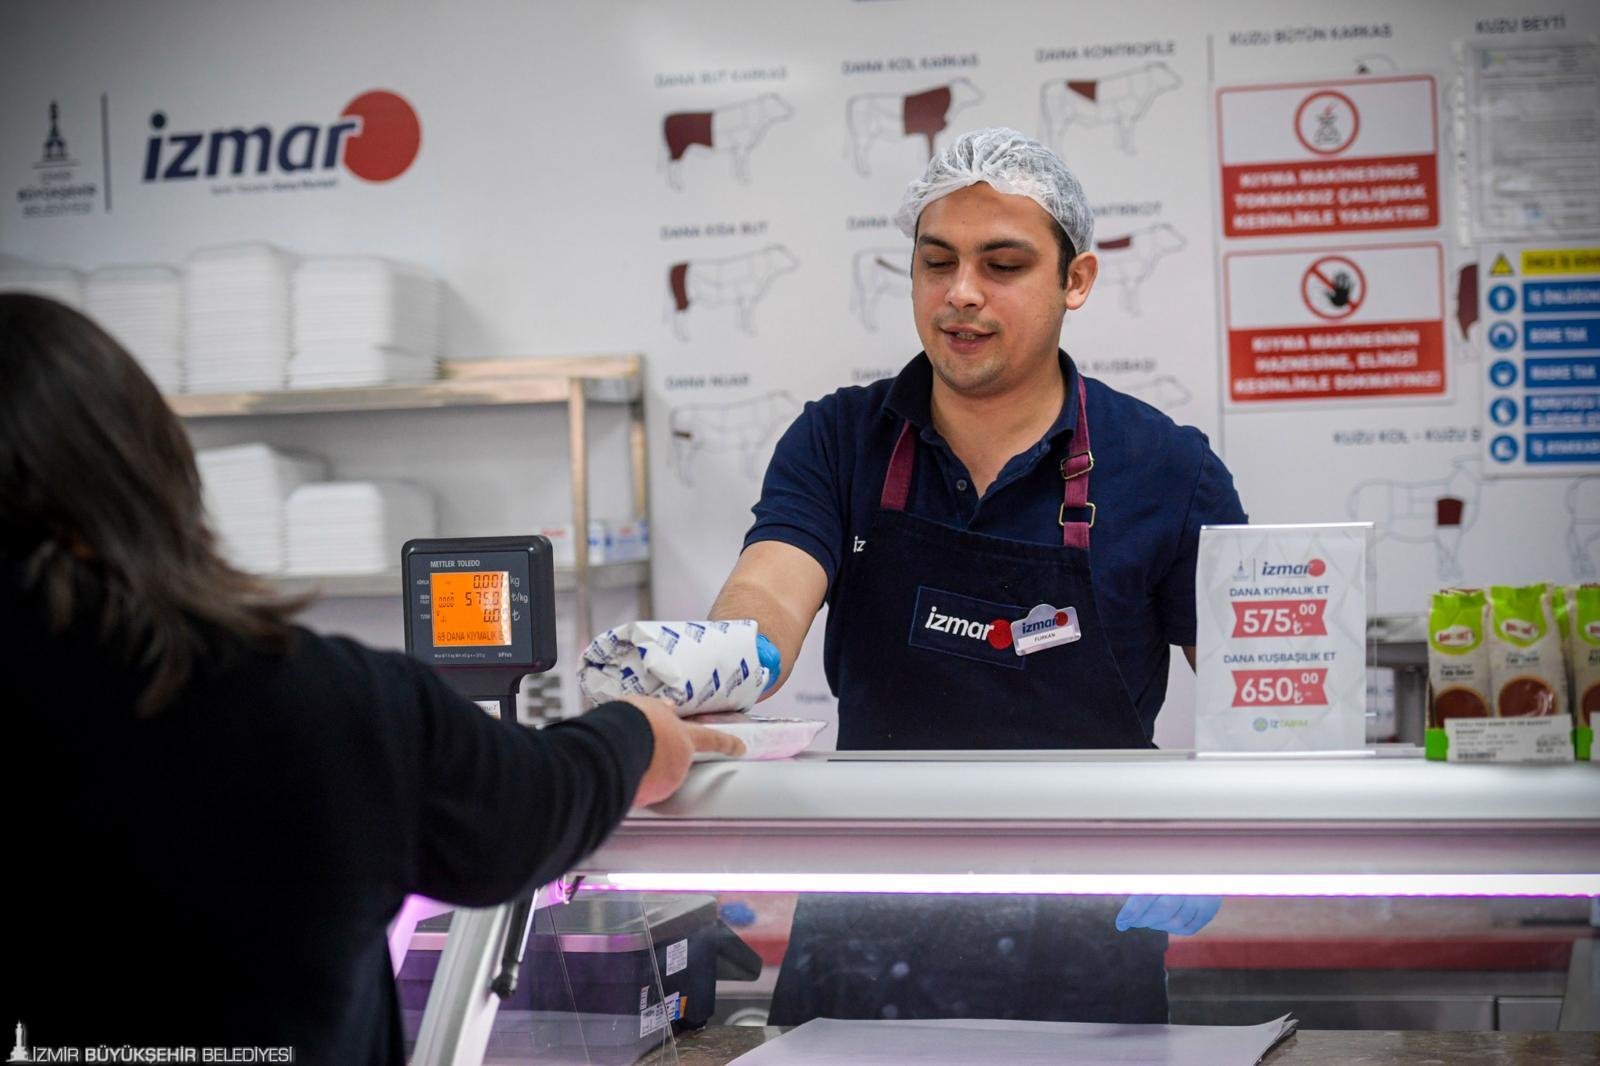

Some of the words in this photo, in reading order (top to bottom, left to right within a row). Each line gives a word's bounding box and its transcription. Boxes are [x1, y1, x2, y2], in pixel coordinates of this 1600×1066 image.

[142, 110, 360, 184] izmar
[430, 560, 455, 568] METTLER
[457, 559, 481, 567] TOLEDO
[1262, 561, 1311, 576] izmar
[1229, 588, 1261, 597] DANA
[1263, 586, 1314, 596] KIYMALIK
[1316, 585, 1329, 595] ET
[925, 606, 995, 641] izmar
[1022, 617, 1057, 634] izmar
[446, 631, 465, 641] DANA
[1034, 632, 1056, 642] FURKAN
[1223, 654, 1255, 664] DANA
[1258, 652, 1320, 663] KUŞBAŞILIK
[1323, 651, 1336, 661] ET
